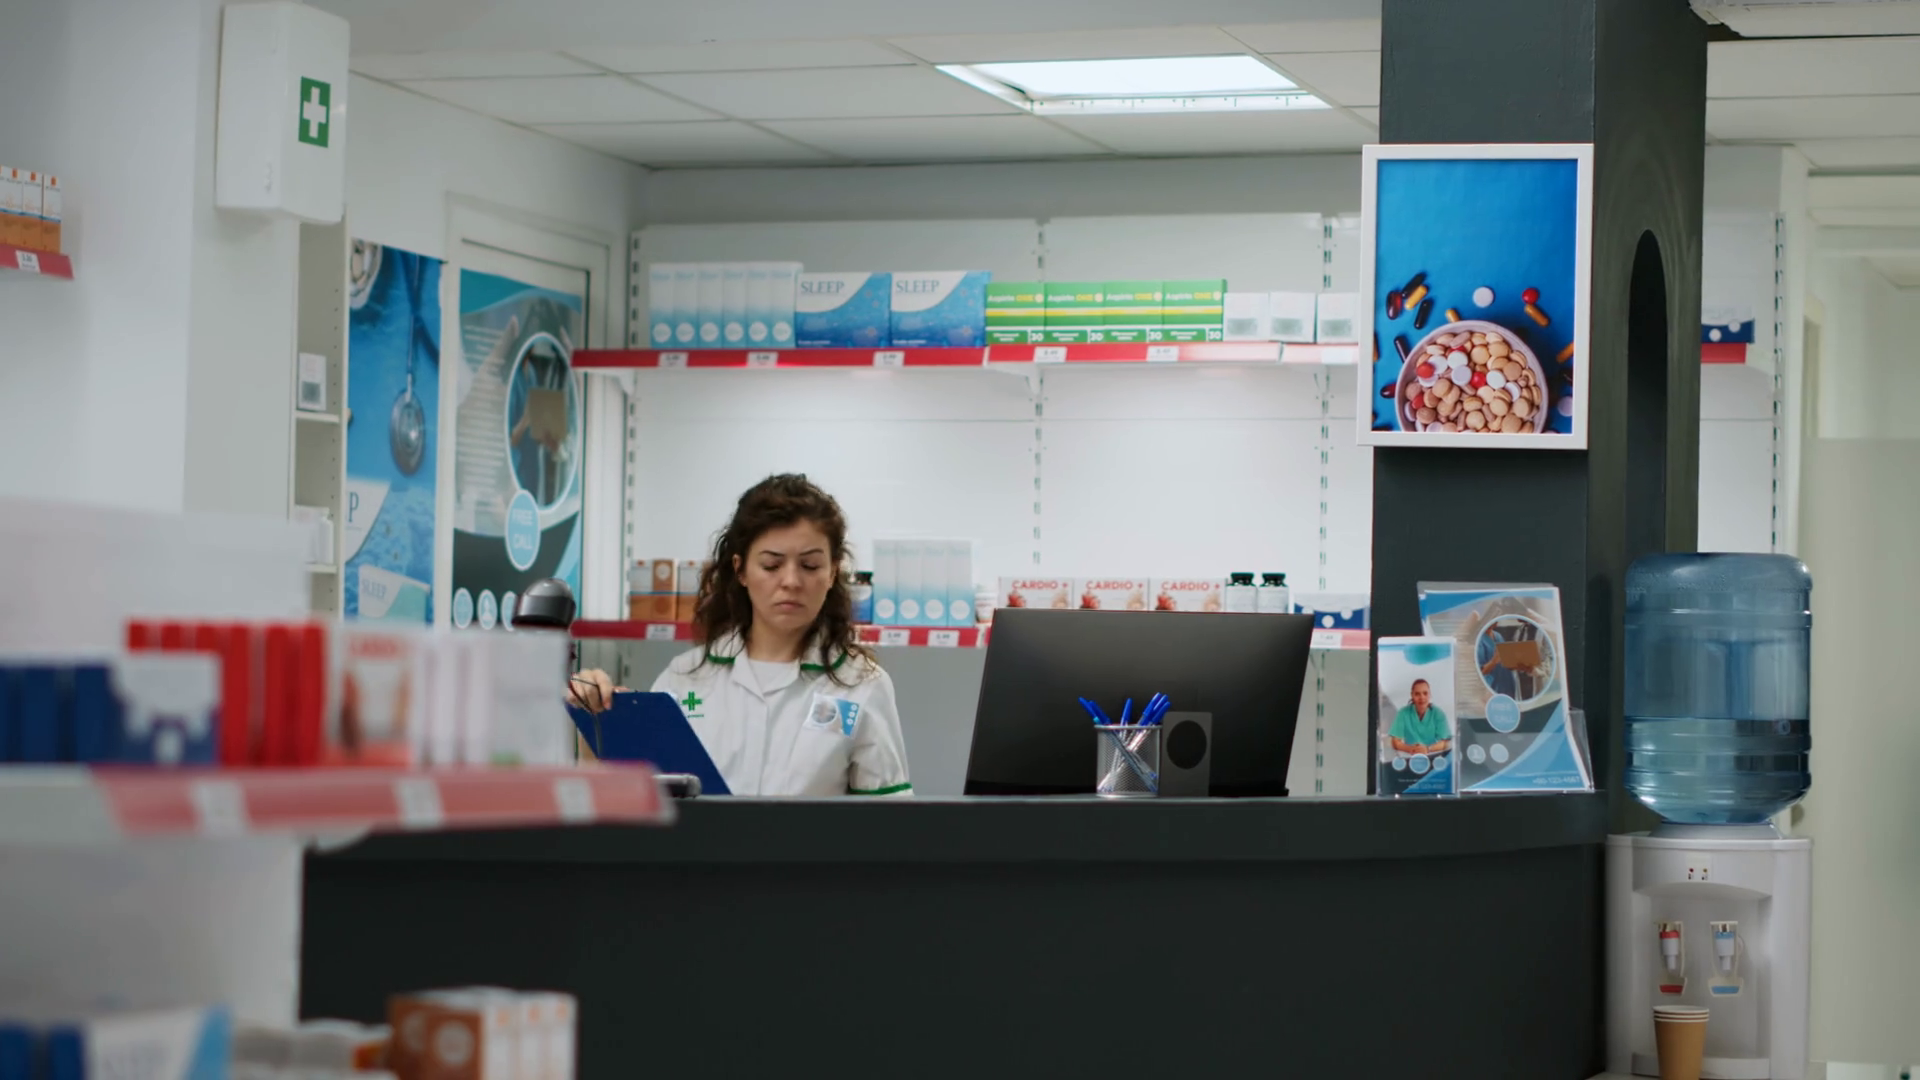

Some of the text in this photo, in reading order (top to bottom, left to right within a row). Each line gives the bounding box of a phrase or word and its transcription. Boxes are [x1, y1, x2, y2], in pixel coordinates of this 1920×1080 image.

[800, 281, 845, 294] SLEEP
[896, 280, 940, 293] SLEEP
[1030, 333, 1044, 341] 30
[1090, 332, 1104, 341] 30
[1149, 331, 1162, 340] 30
[1208, 331, 1221, 339] 30
[1011, 581, 1058, 590] CARDIO
[1086, 581, 1133, 590] CARDIO
[1161, 581, 1209, 591] CARDIO
